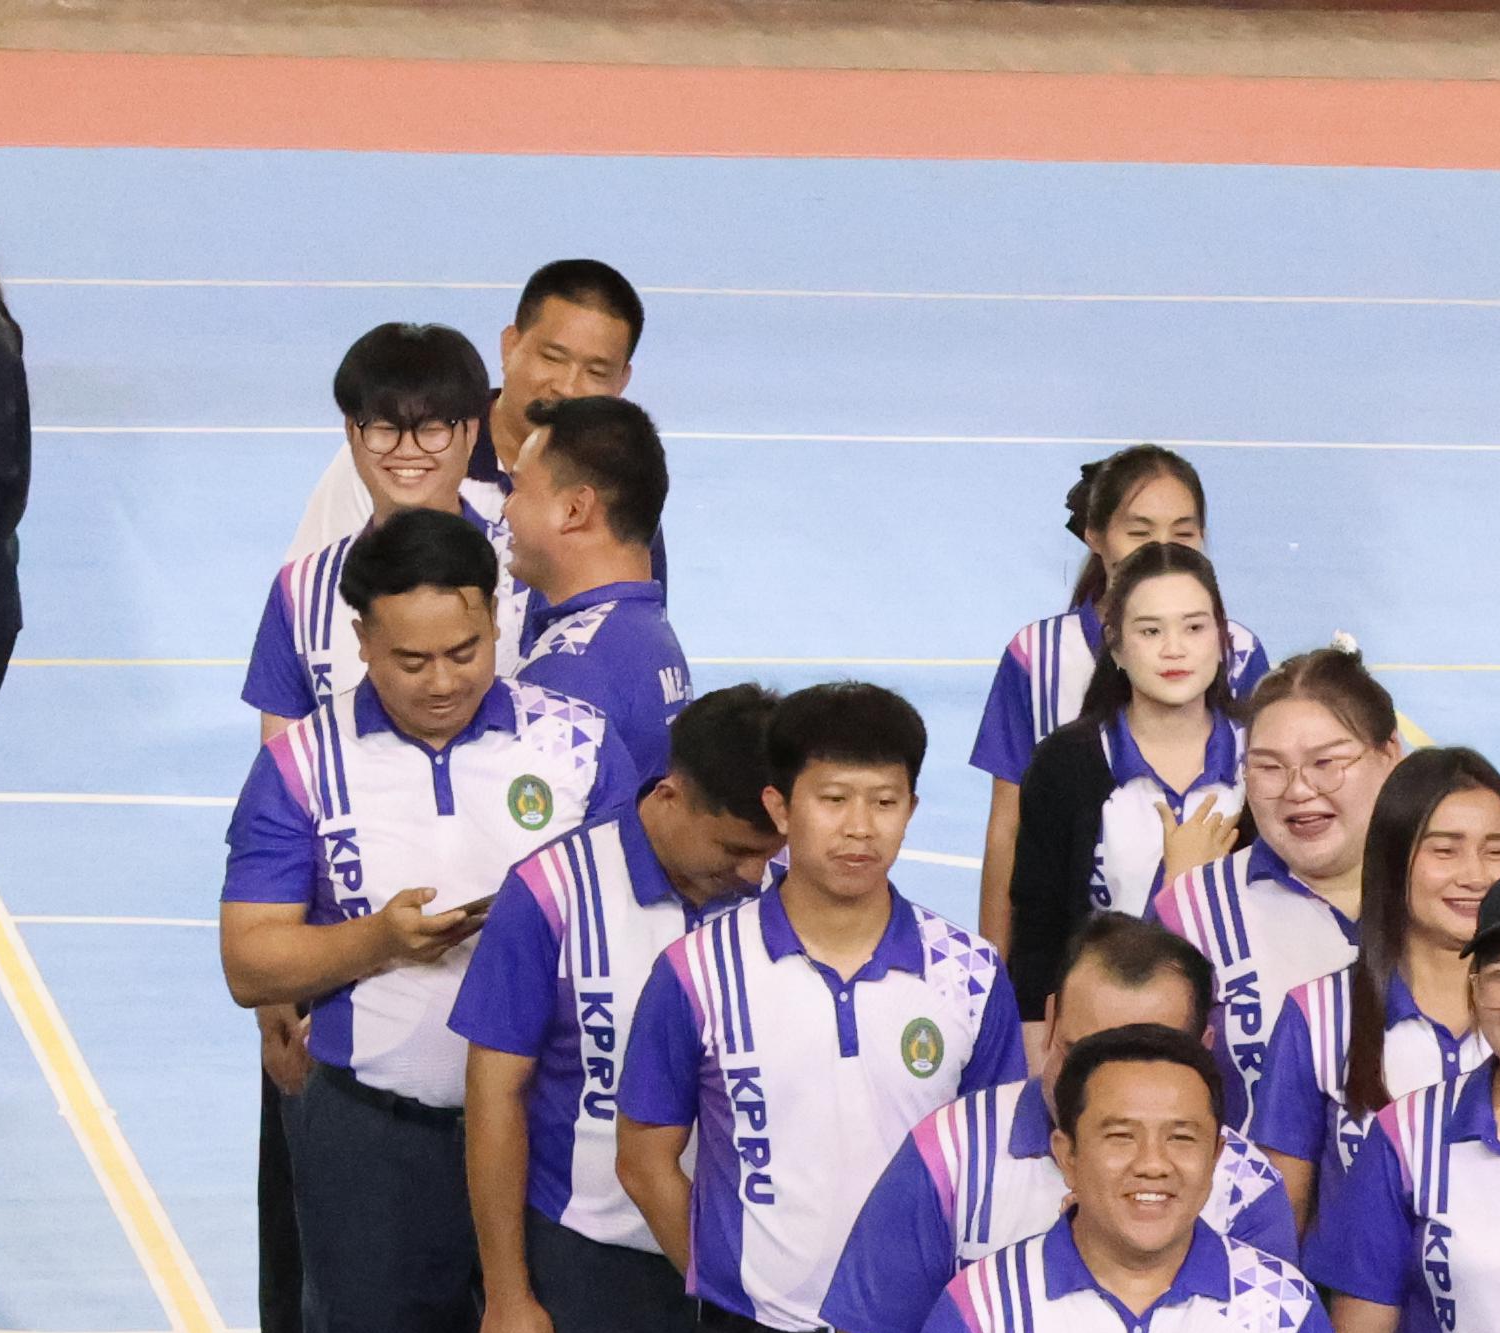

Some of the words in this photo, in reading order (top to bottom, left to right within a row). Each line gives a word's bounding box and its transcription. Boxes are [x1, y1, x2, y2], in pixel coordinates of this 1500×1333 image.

[325, 828, 372, 920] KPR
[1089, 856, 1112, 907] KP
[580, 991, 616, 1121] KPRU
[1225, 971, 1267, 1073] KPR
[728, 1066, 775, 1205] KPRU
